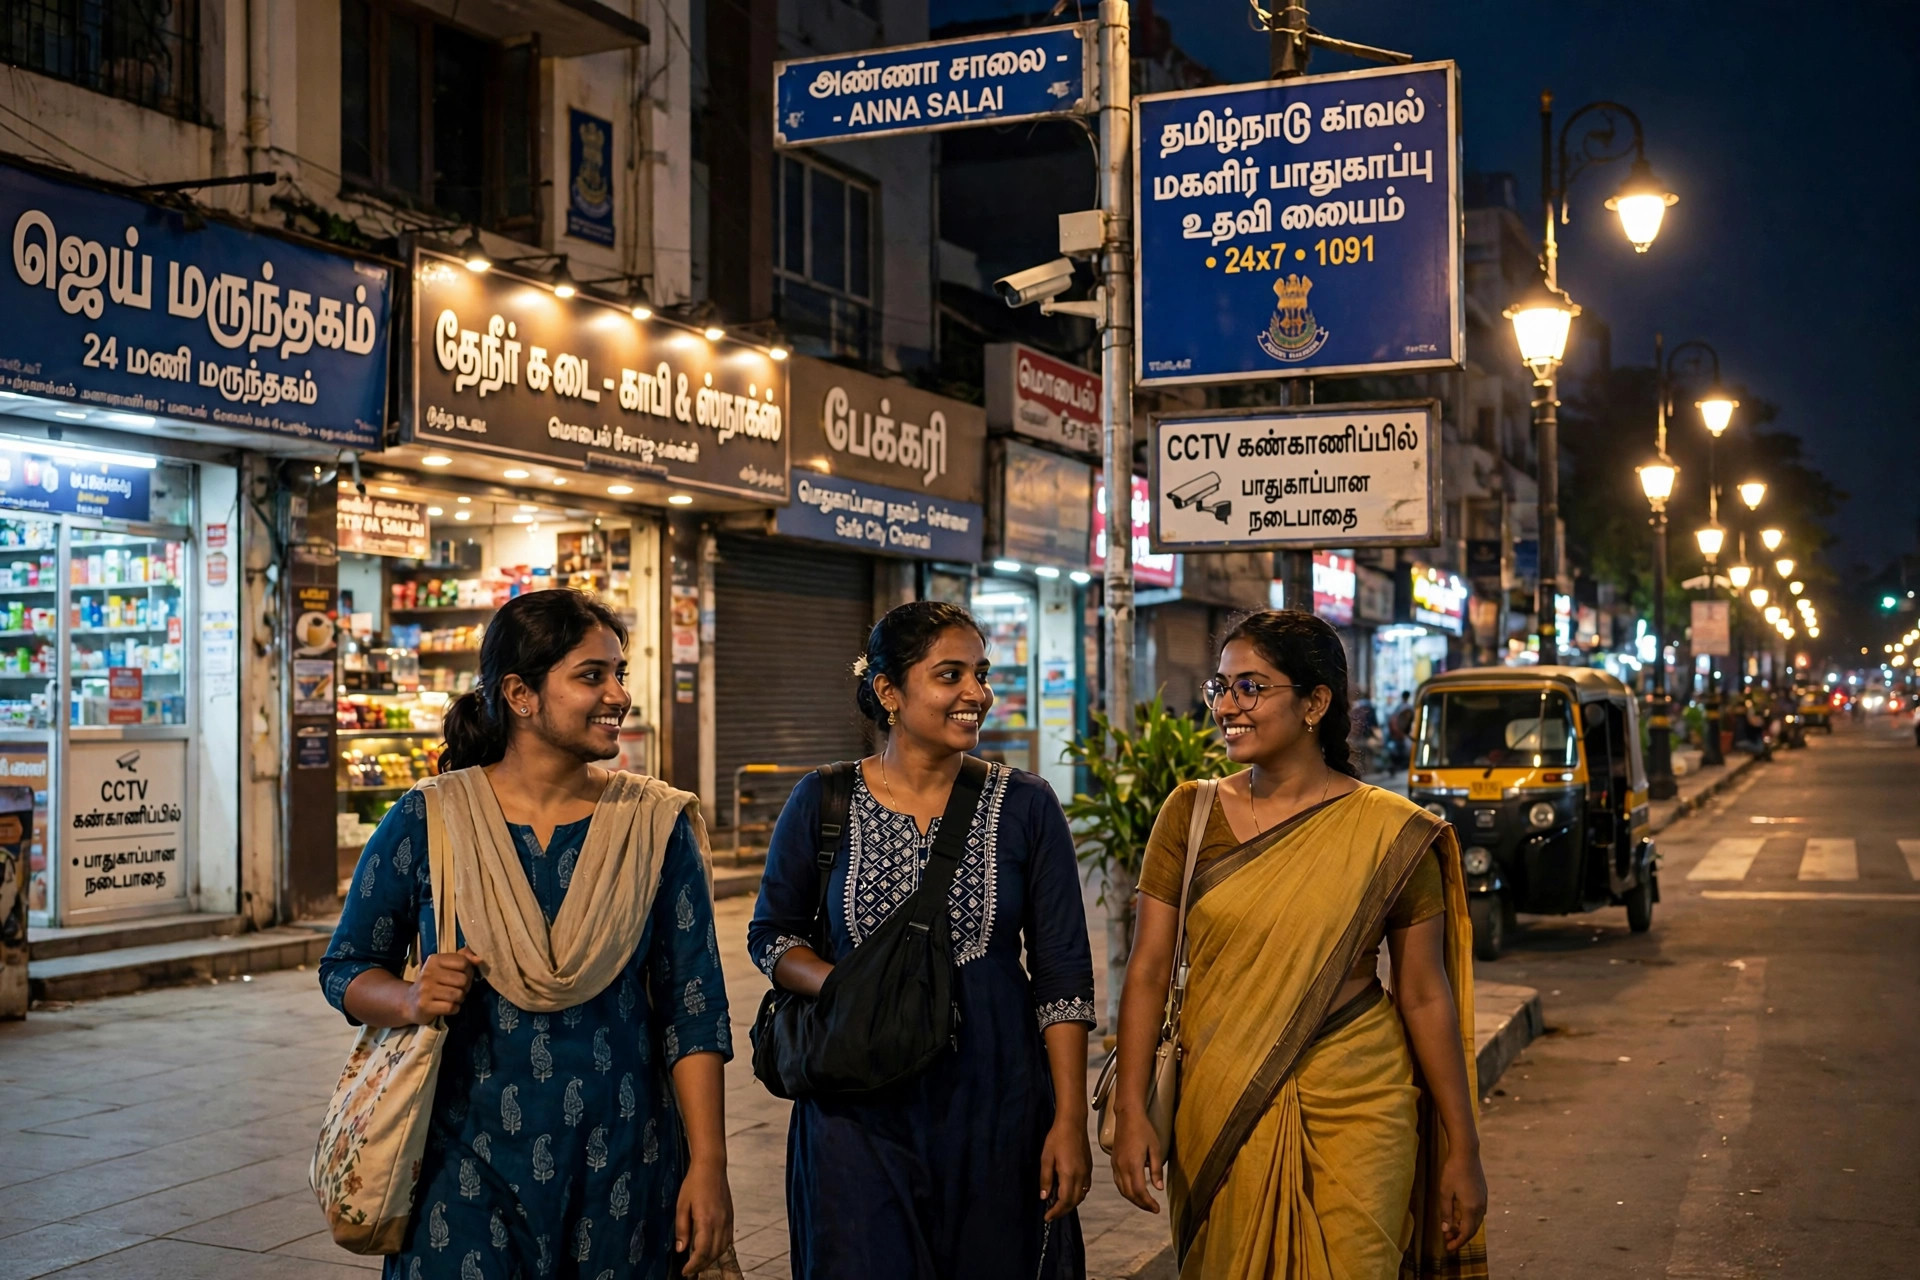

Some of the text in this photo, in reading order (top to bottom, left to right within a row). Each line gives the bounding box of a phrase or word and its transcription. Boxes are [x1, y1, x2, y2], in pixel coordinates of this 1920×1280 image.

[809, 60, 940, 98] அண்ணா
[949, 48, 1046, 81] சாலை
[849, 96, 921, 127] ANNA
[927, 86, 1003, 117] SALAI
[1160, 88, 1425, 158] தமிழ்நாடு காவல்
[1154, 142, 1433, 200] மகளிர் பாதுகாப்பு
[1182, 198, 1272, 246] உதவி
[1225, 235, 1374, 274] 24x7 1091
[13, 209, 376, 359] ஜெய் மருந்தகம்
[83, 333, 118, 369] 24
[127, 346, 190, 382] மணி
[199, 360, 318, 407] மருந்தகம்
[436, 309, 522, 397] தேநீர்
[527, 346, 600, 402] கடை
[619, 361, 671, 418] காபி
[675, 372, 692, 423] &
[824, 386, 947, 486] பேக்கரி
[1167, 423, 1418, 460] CCTV கண்காணிப்பில்
[1242, 469, 1370, 503] பாதுகாப்பான
[1248, 507, 1358, 536] நடைபாதை
[101, 780, 148, 802] CCTV
[73, 803, 181, 828] கண்காணிப்பில்
[84, 845, 176, 873] பாதுகாப்பான
[84, 871, 166, 897] நடைபாதை
